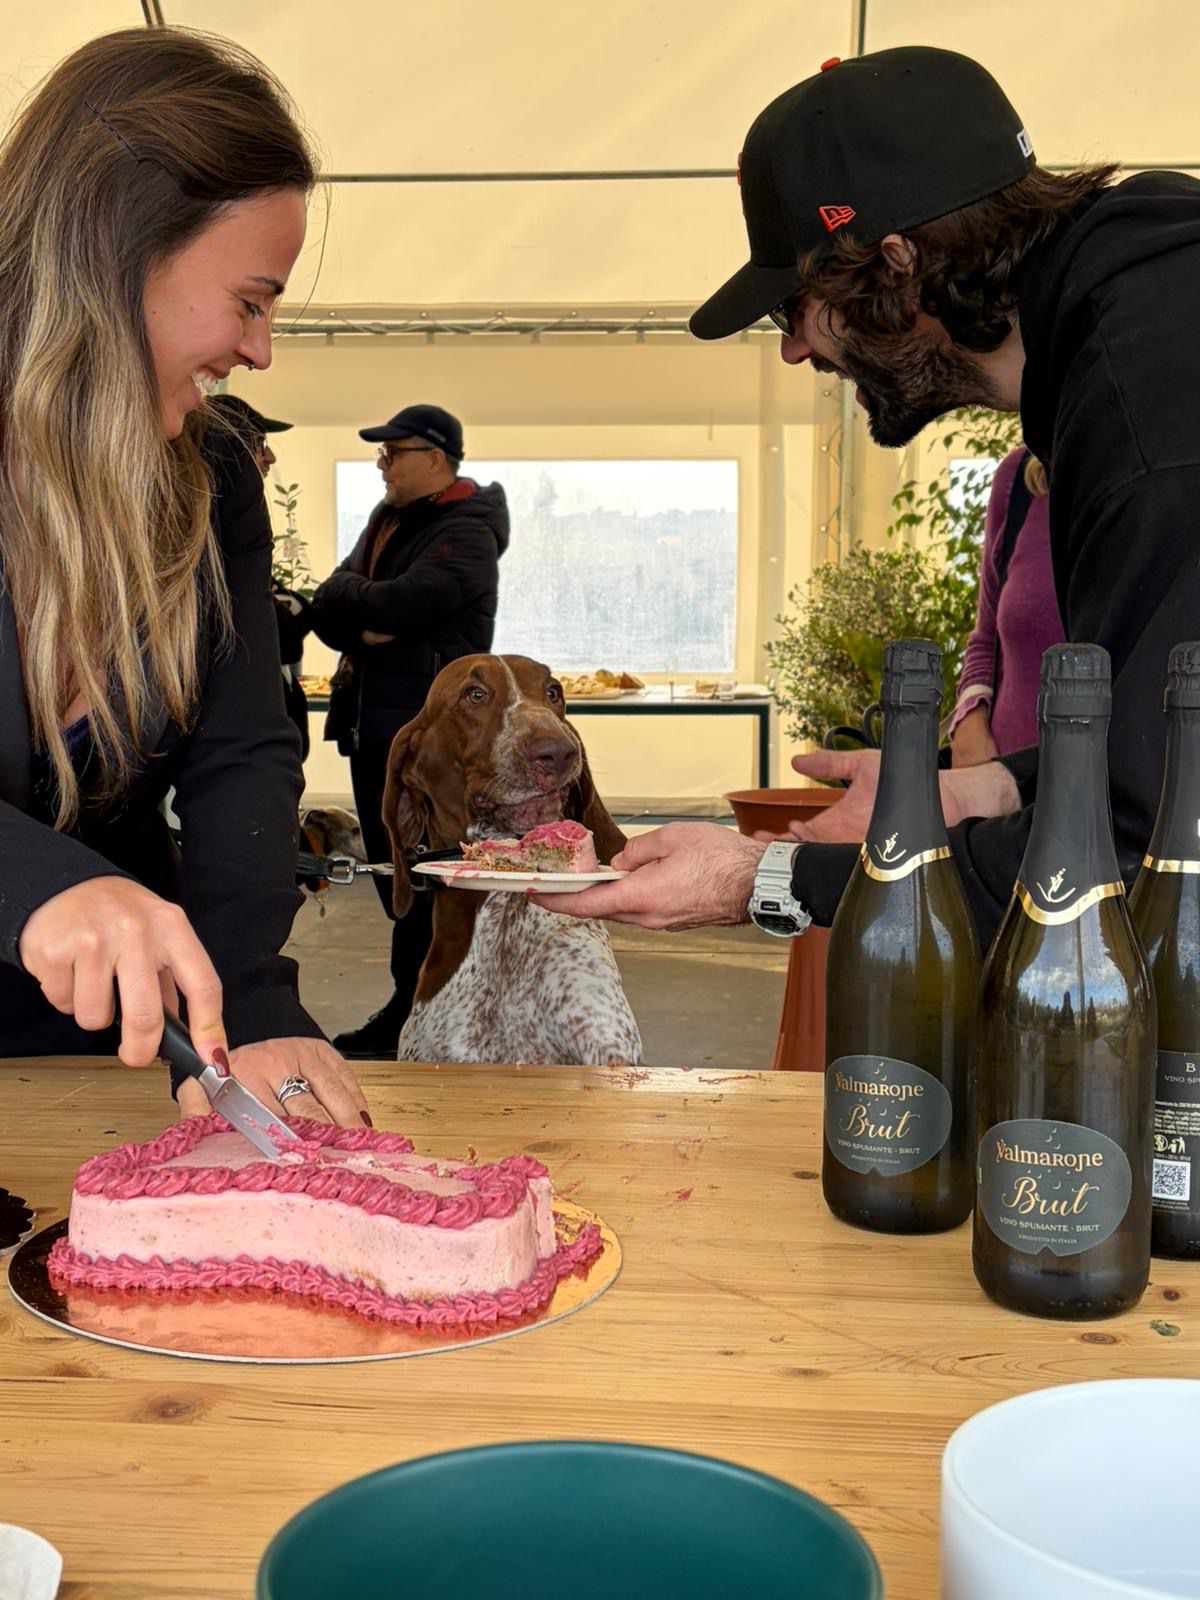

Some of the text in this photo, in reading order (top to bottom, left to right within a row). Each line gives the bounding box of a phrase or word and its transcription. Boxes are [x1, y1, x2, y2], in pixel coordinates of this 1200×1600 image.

[1164, 1075, 1200, 1085] VINO SP
[839, 1104, 921, 1140] Brut
[838, 1139, 851, 1148] VINO
[852, 1142, 893, 1154] SPUMANTE
[899, 1147, 921, 1155] BRUT
[1001, 1176, 1100, 1216] Brut
[1000, 1216, 1017, 1226] VINO
[1019, 1220, 1069, 1232] SPUMANTE
[1076, 1223, 1101, 1232] BRUT
[1018, 1234, 1050, 1243] PRODOTTO
